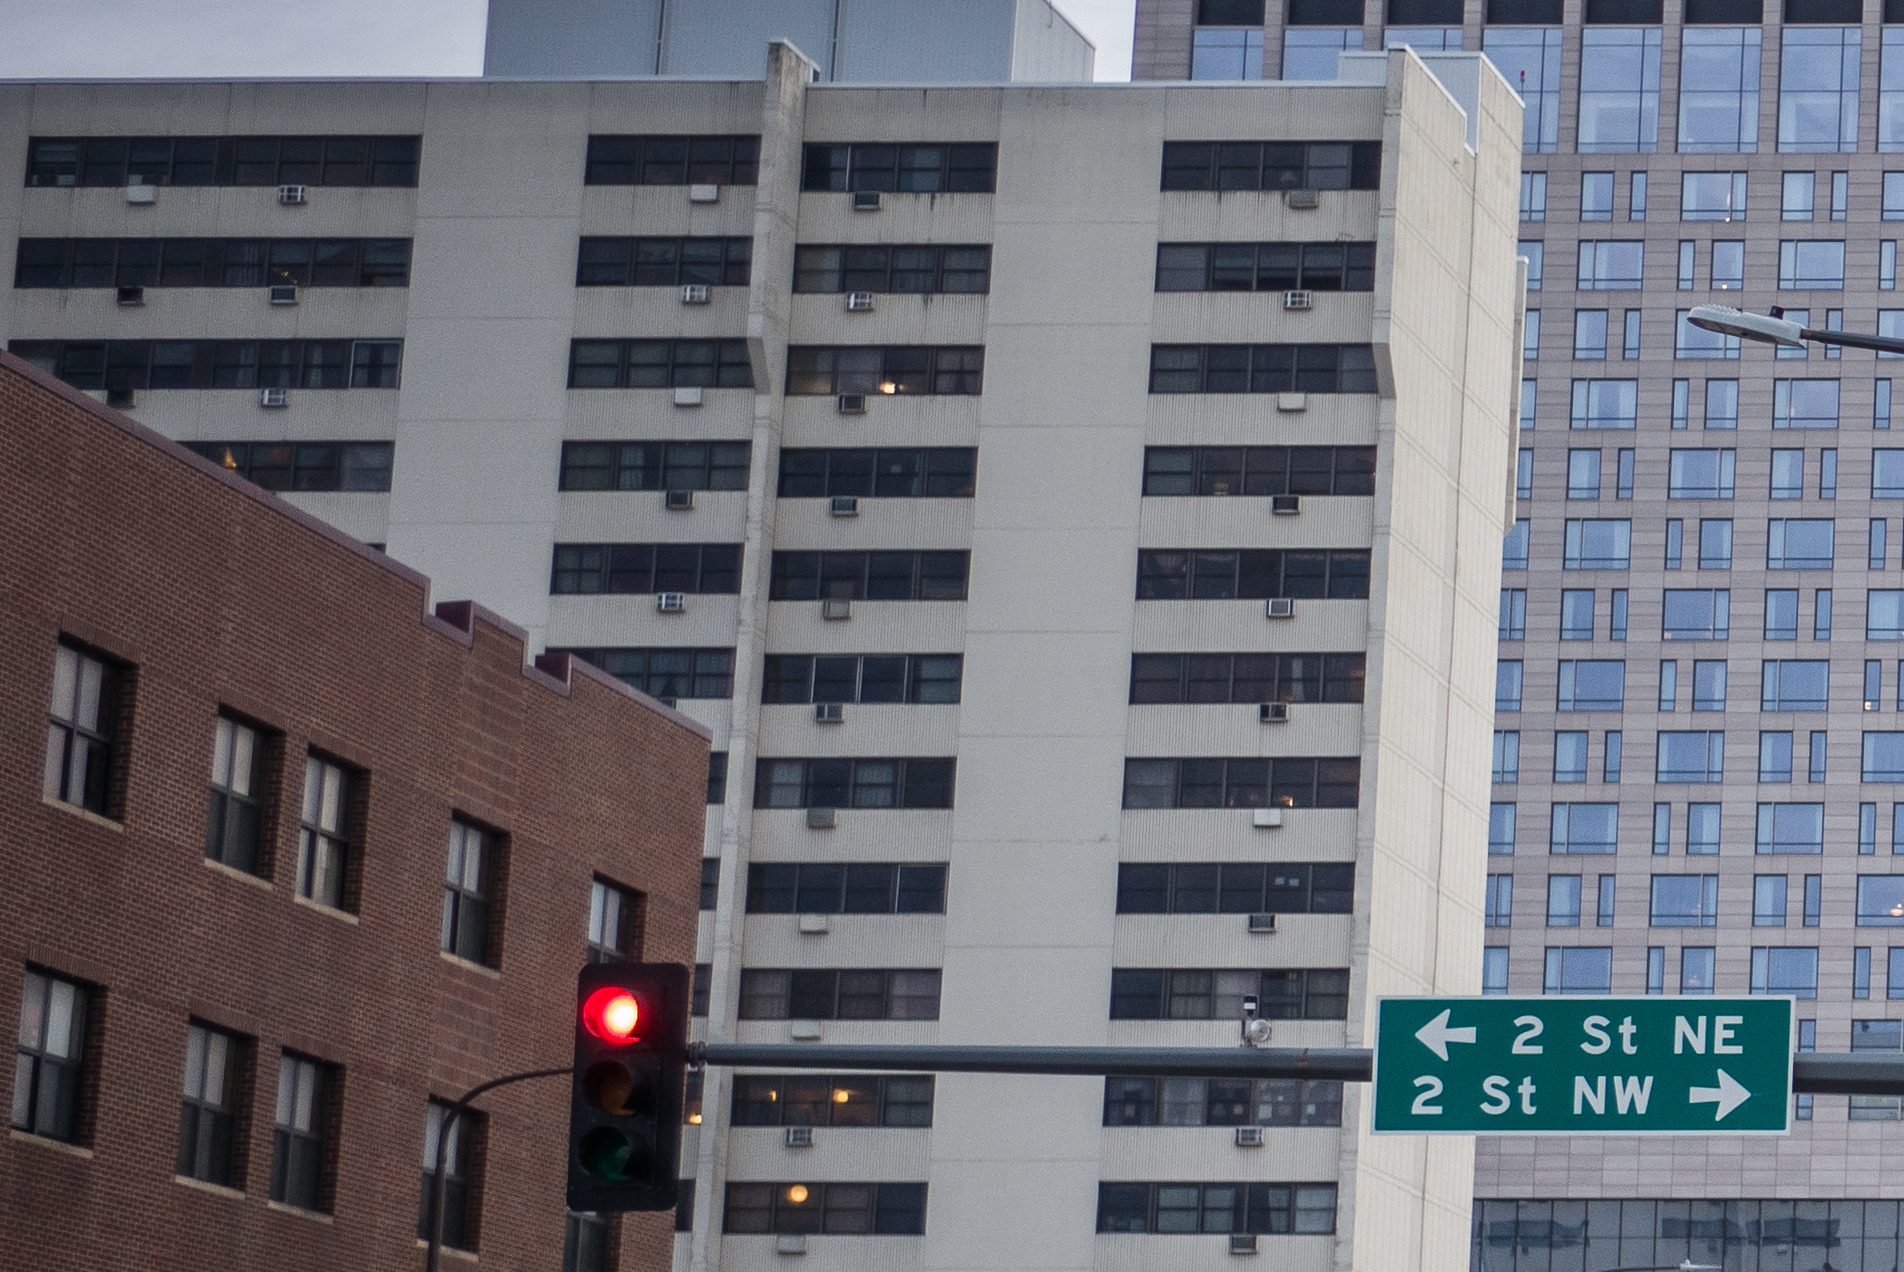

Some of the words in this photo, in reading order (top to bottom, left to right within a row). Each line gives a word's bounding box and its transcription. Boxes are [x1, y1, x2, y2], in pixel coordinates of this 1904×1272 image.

[1511, 1015, 1545, 1056] 2
[1580, 1015, 1638, 1056] St
[1673, 1015, 1744, 1055] NE
[1410, 1075, 1444, 1116] 2
[1480, 1075, 1538, 1116] St
[1573, 1076, 1654, 1116] NW
